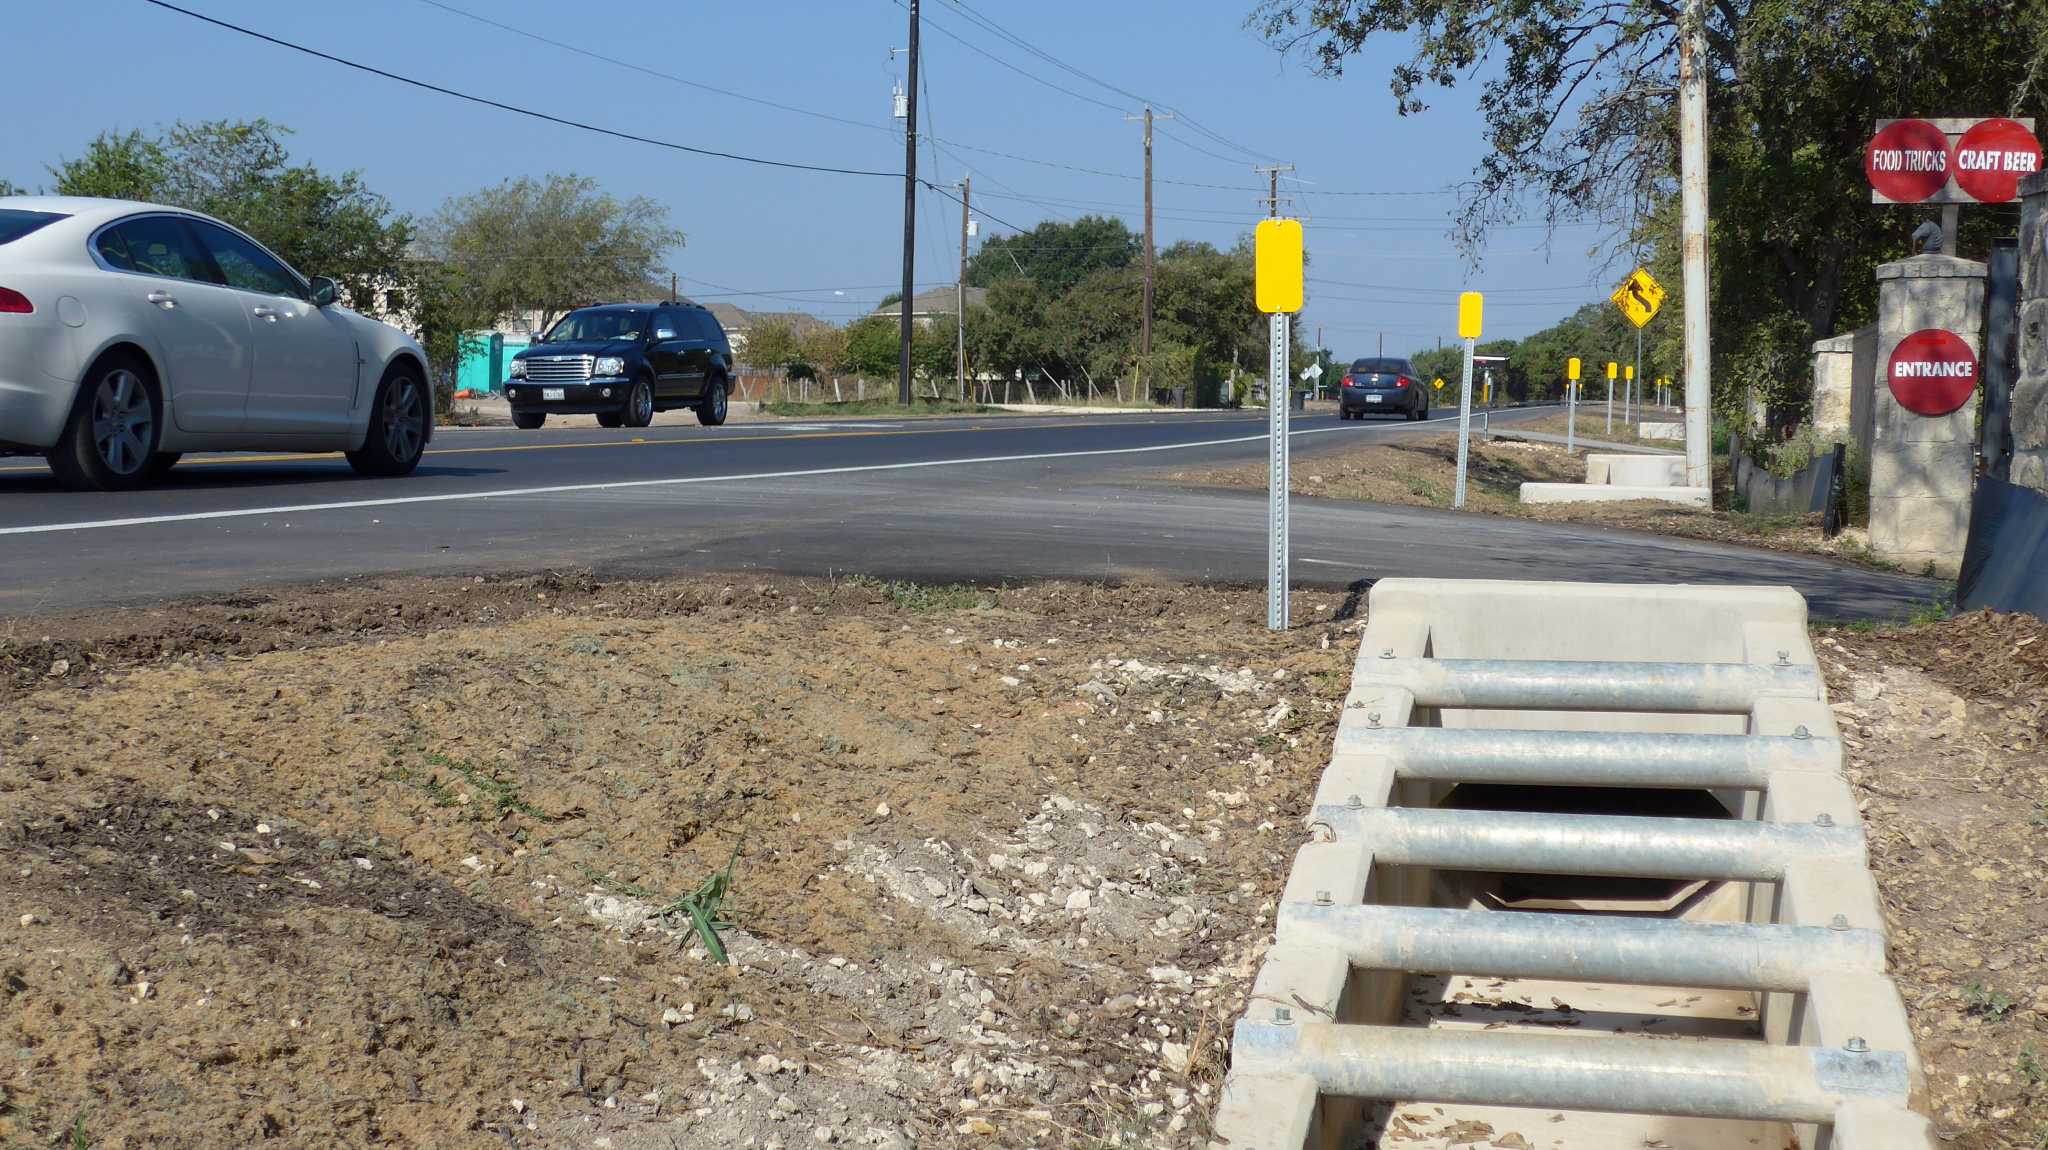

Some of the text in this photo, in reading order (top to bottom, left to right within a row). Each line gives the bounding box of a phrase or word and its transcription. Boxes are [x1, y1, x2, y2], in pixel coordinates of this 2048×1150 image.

[1873, 150, 1946, 172] FOOD TRUCKS
[1958, 150, 2036, 172] CRAFT BEER
[1895, 361, 1973, 377] ENTRANCE
